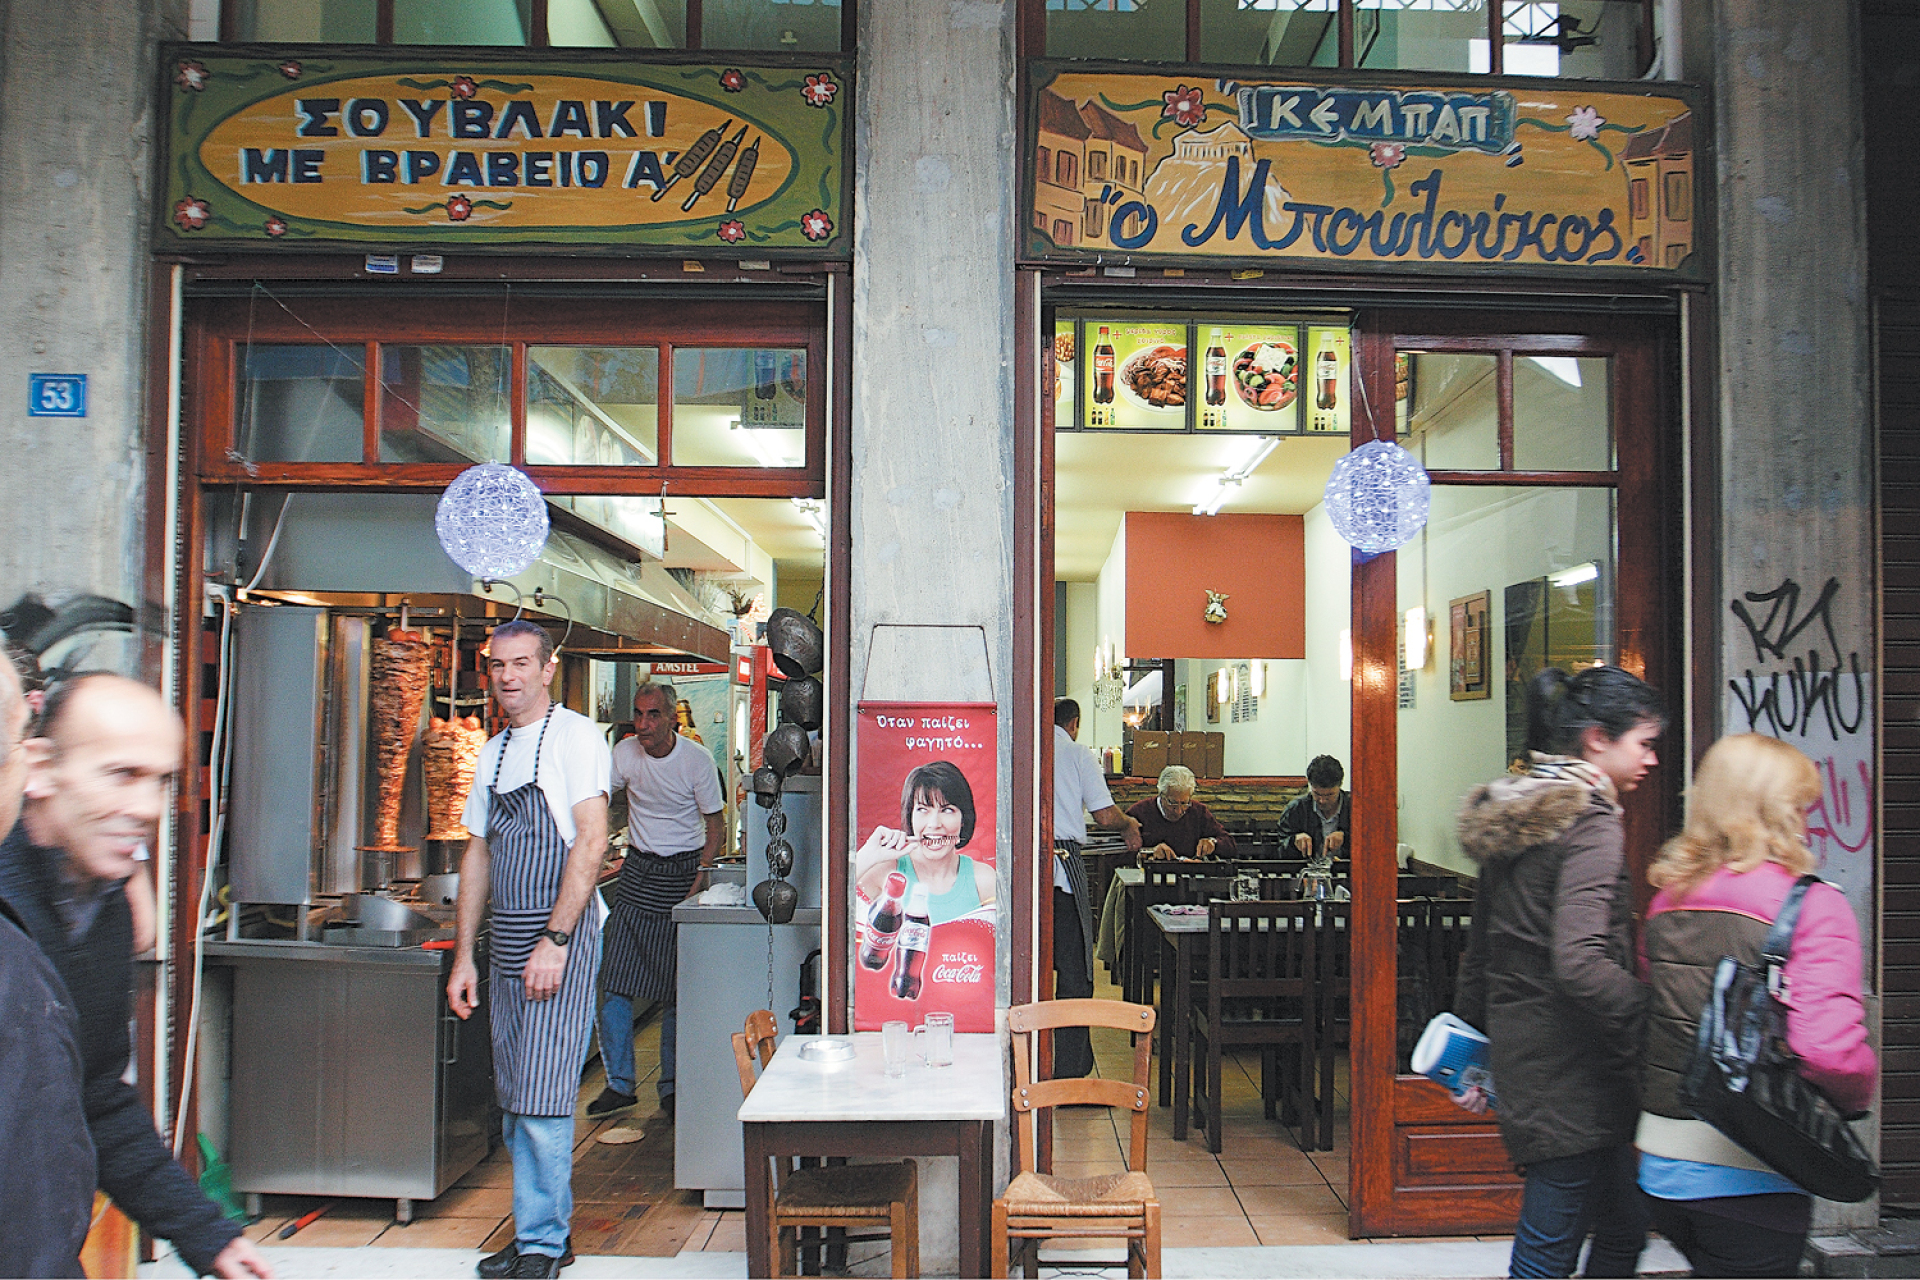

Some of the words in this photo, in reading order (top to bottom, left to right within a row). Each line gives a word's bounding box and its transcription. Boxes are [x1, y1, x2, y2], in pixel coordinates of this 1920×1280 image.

[294, 98, 665, 138] ΣΟΥΒΛΑΚΙ
[238, 148, 325, 185] ΜΕ
[359, 150, 610, 188] ΒΡΑΒΕΙΟ
[41, 382, 74, 409] 53
[655, 663, 700, 674] AMSTEL
[876, 714, 915, 728] Όταν
[921, 715, 970, 732] παίζει
[905, 735, 984, 752] φαγητό...
[941, 951, 978, 965] παίζει
[931, 963, 985, 984] Coca-Cola
